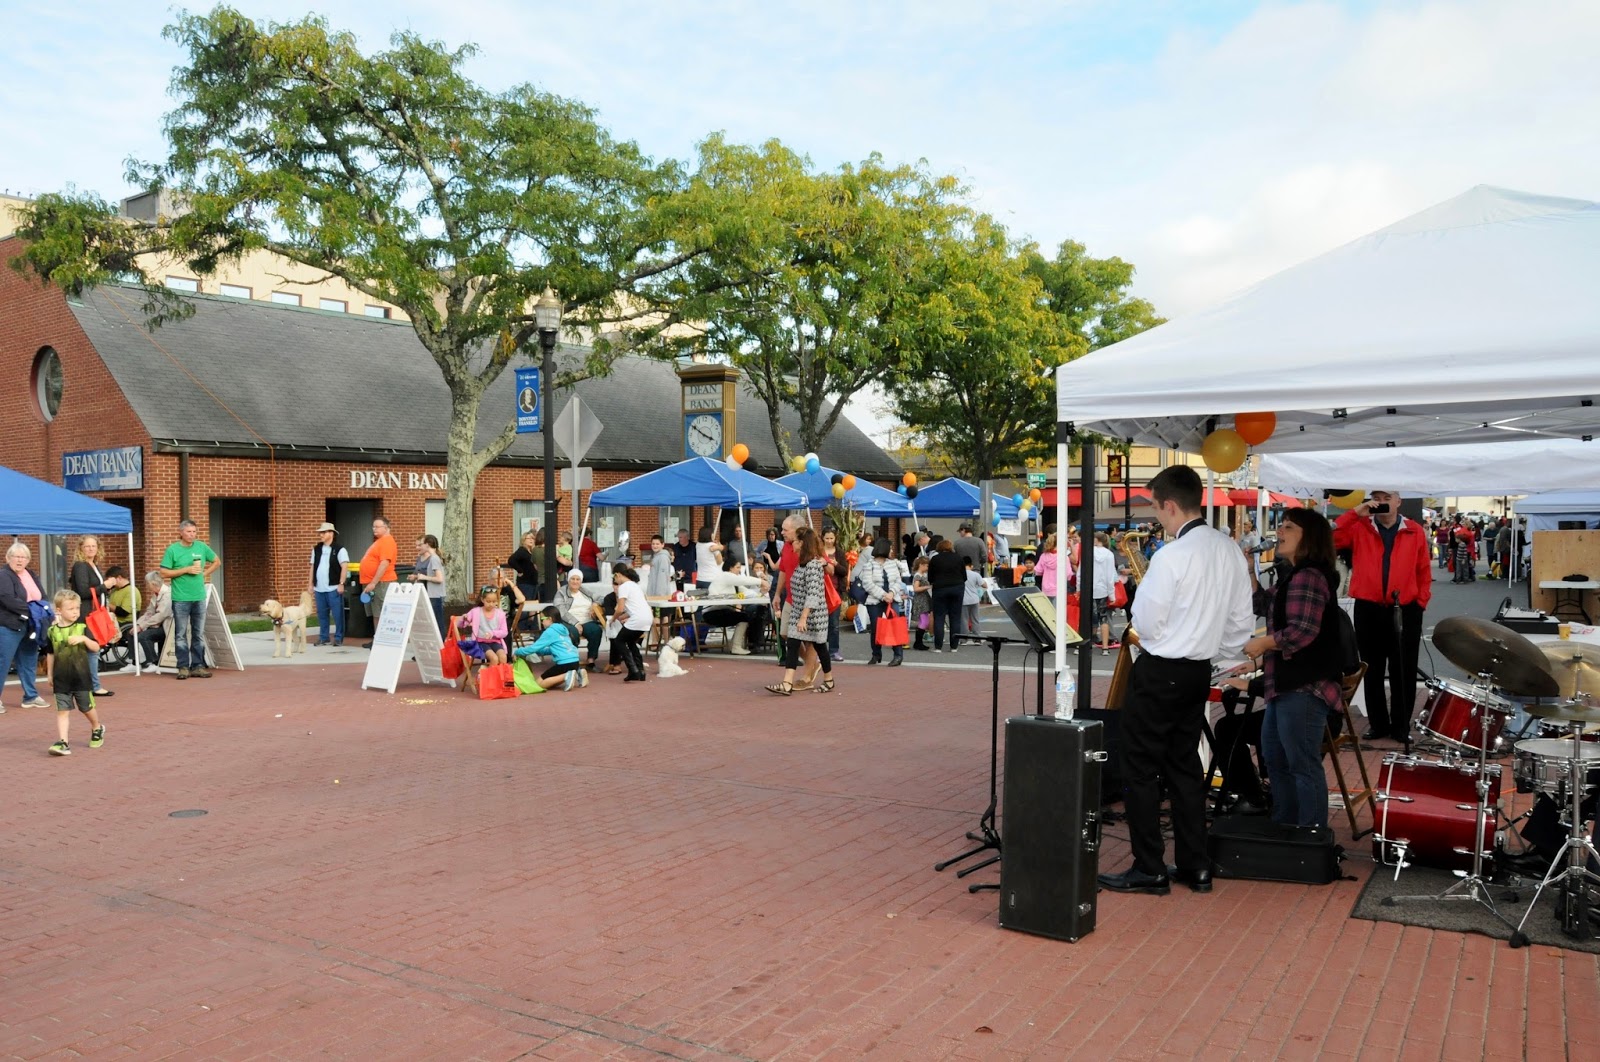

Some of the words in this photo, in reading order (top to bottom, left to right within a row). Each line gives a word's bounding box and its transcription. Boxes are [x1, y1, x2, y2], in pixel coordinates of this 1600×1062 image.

[690, 384, 717, 394] DEAN
[690, 400, 717, 409] BANK
[65, 454, 98, 475] DEAN
[100, 450, 138, 473] BANK
[350, 470, 402, 489] DEAN
